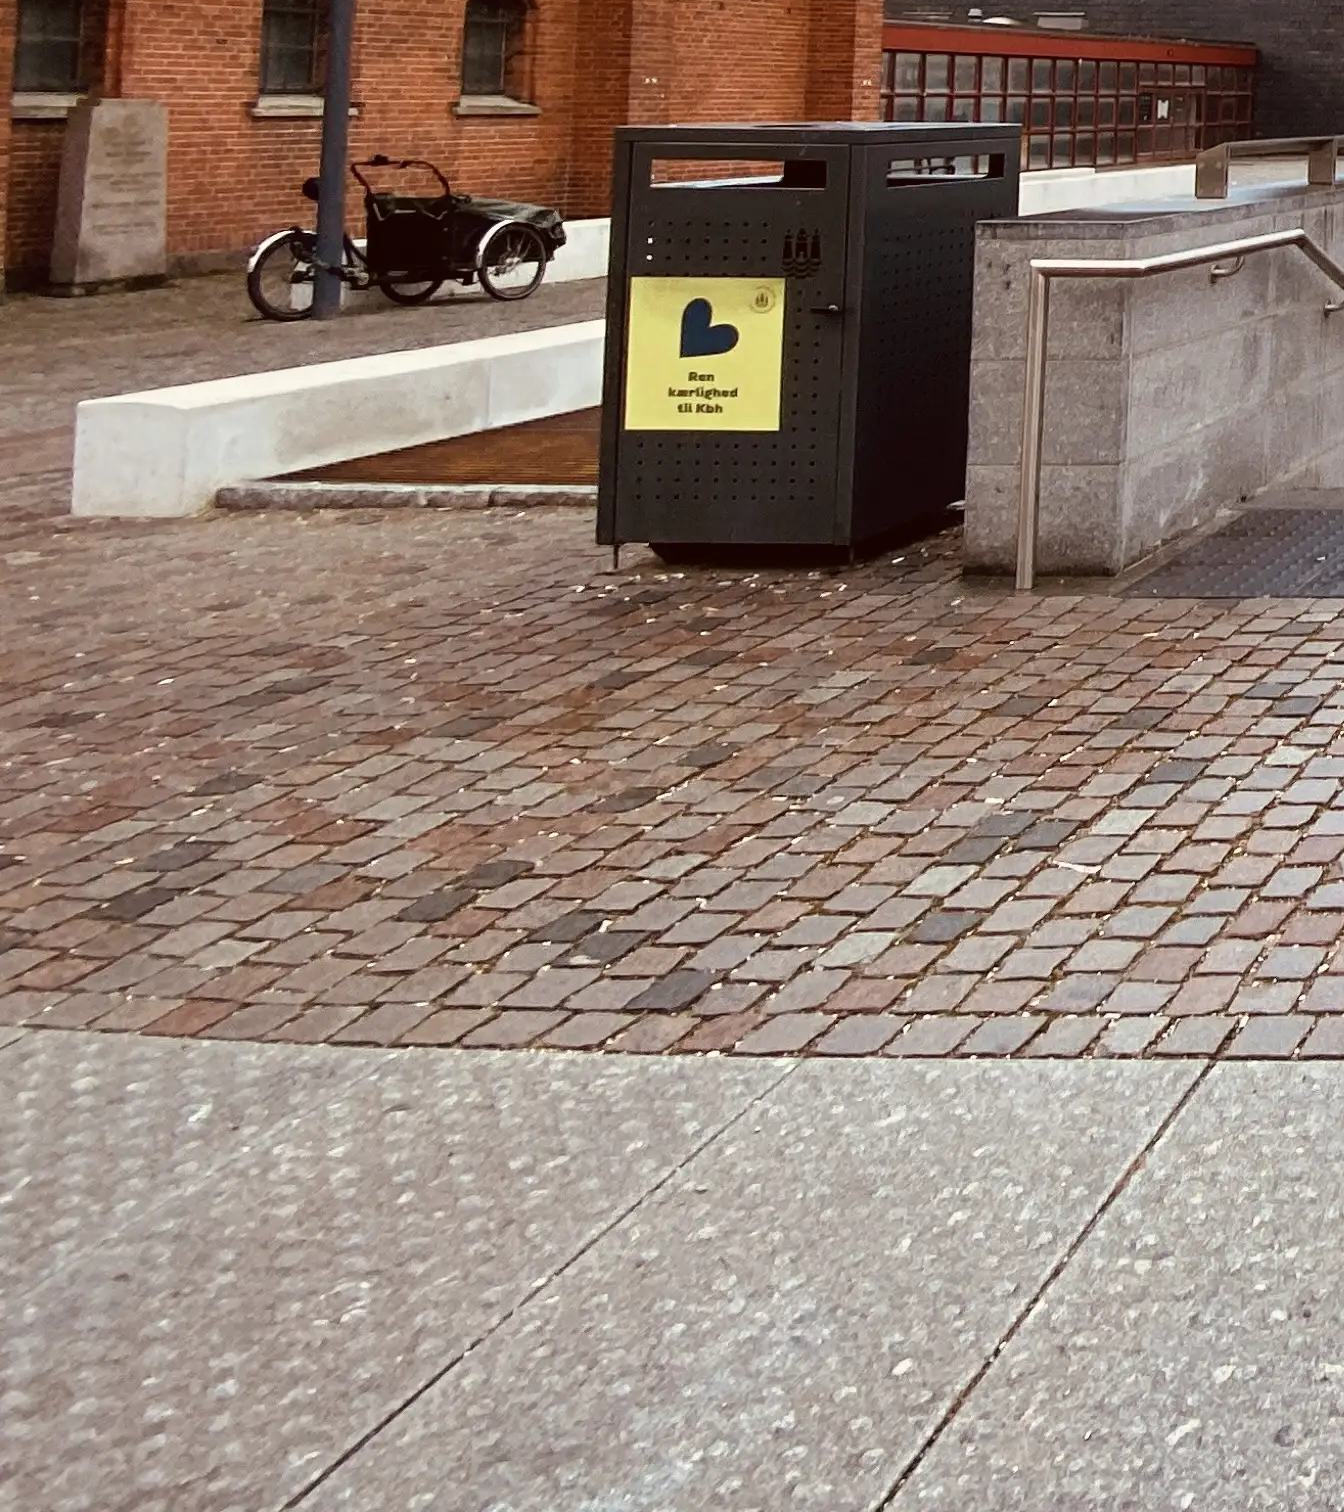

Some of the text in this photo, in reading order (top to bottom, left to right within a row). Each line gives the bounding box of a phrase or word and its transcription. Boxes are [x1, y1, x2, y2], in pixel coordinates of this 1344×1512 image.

[688, 372, 715, 382] Ren
[668, 387, 738, 400] kærlighed
[677, 403, 723, 413] til Kbh
